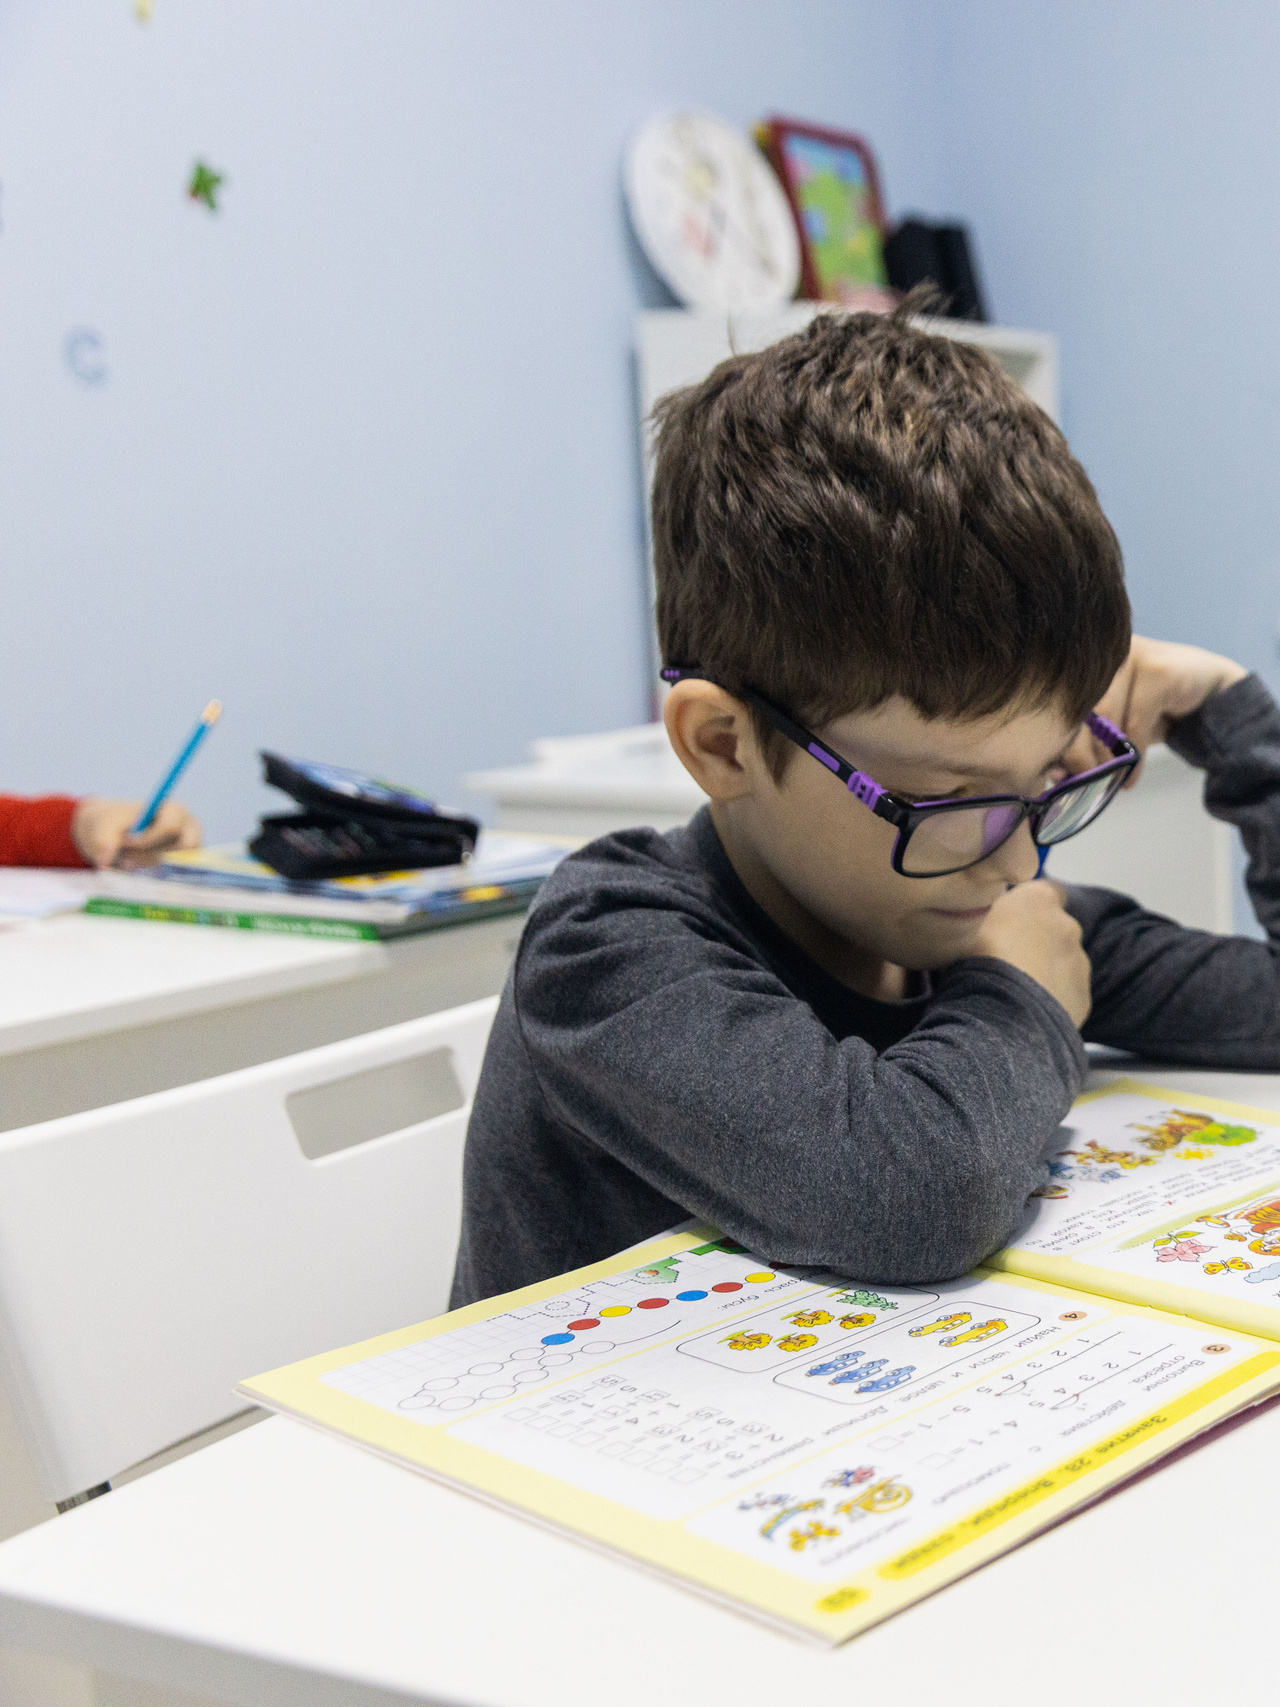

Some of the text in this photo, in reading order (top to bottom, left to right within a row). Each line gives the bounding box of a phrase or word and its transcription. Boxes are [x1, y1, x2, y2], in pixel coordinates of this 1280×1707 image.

[1091, 1208, 1116, 1219] Кто
[1100, 1200, 1156, 1222] Шапочки,
[1050, 1221, 1085, 1236] какой
[1104, 1219, 1127, 1229] кто
[1025, 1238, 1043, 1246] по
[1038, 1232, 1078, 1248] синим
[1068, 1231, 1101, 1244] стоит
[717, 1270, 823, 1310] аскрась бусы:
[1062, 1311, 1080, 1320] 4
[1012, 1326, 1059, 1347] Найди
[1048, 1349, 1066, 1357] 2
[1205, 1343, 1226, 1353] 3
[968, 1350, 1009, 1368] части
[1024, 1361, 1042, 1369] 3
[1101, 1361, 1119, 1369] 2
[1126, 1355, 1187, 1385] отрезка.
[999, 1373, 1017, 1381] 4
[1077, 1373, 1095, 1382] 3
[1141, 1359, 1204, 1391] Выполни
[895, 1380, 944, 1403] целое.
[974, 1385, 992, 1394] 5
[1051, 1386, 1070, 1395] 4
[950, 1404, 970, 1413] 5
[1026, 1399, 1045, 1408] 5
[822, 1406, 889, 1435] Допиши
[1057, 1400, 1128, 1436] действия
[1001, 1419, 1020, 1428] 4
[1093, 1416, 1166, 1453] Занятие
[1026, 1445, 1043, 1453] с
[1059, 1458, 1091, 1473] 28.
